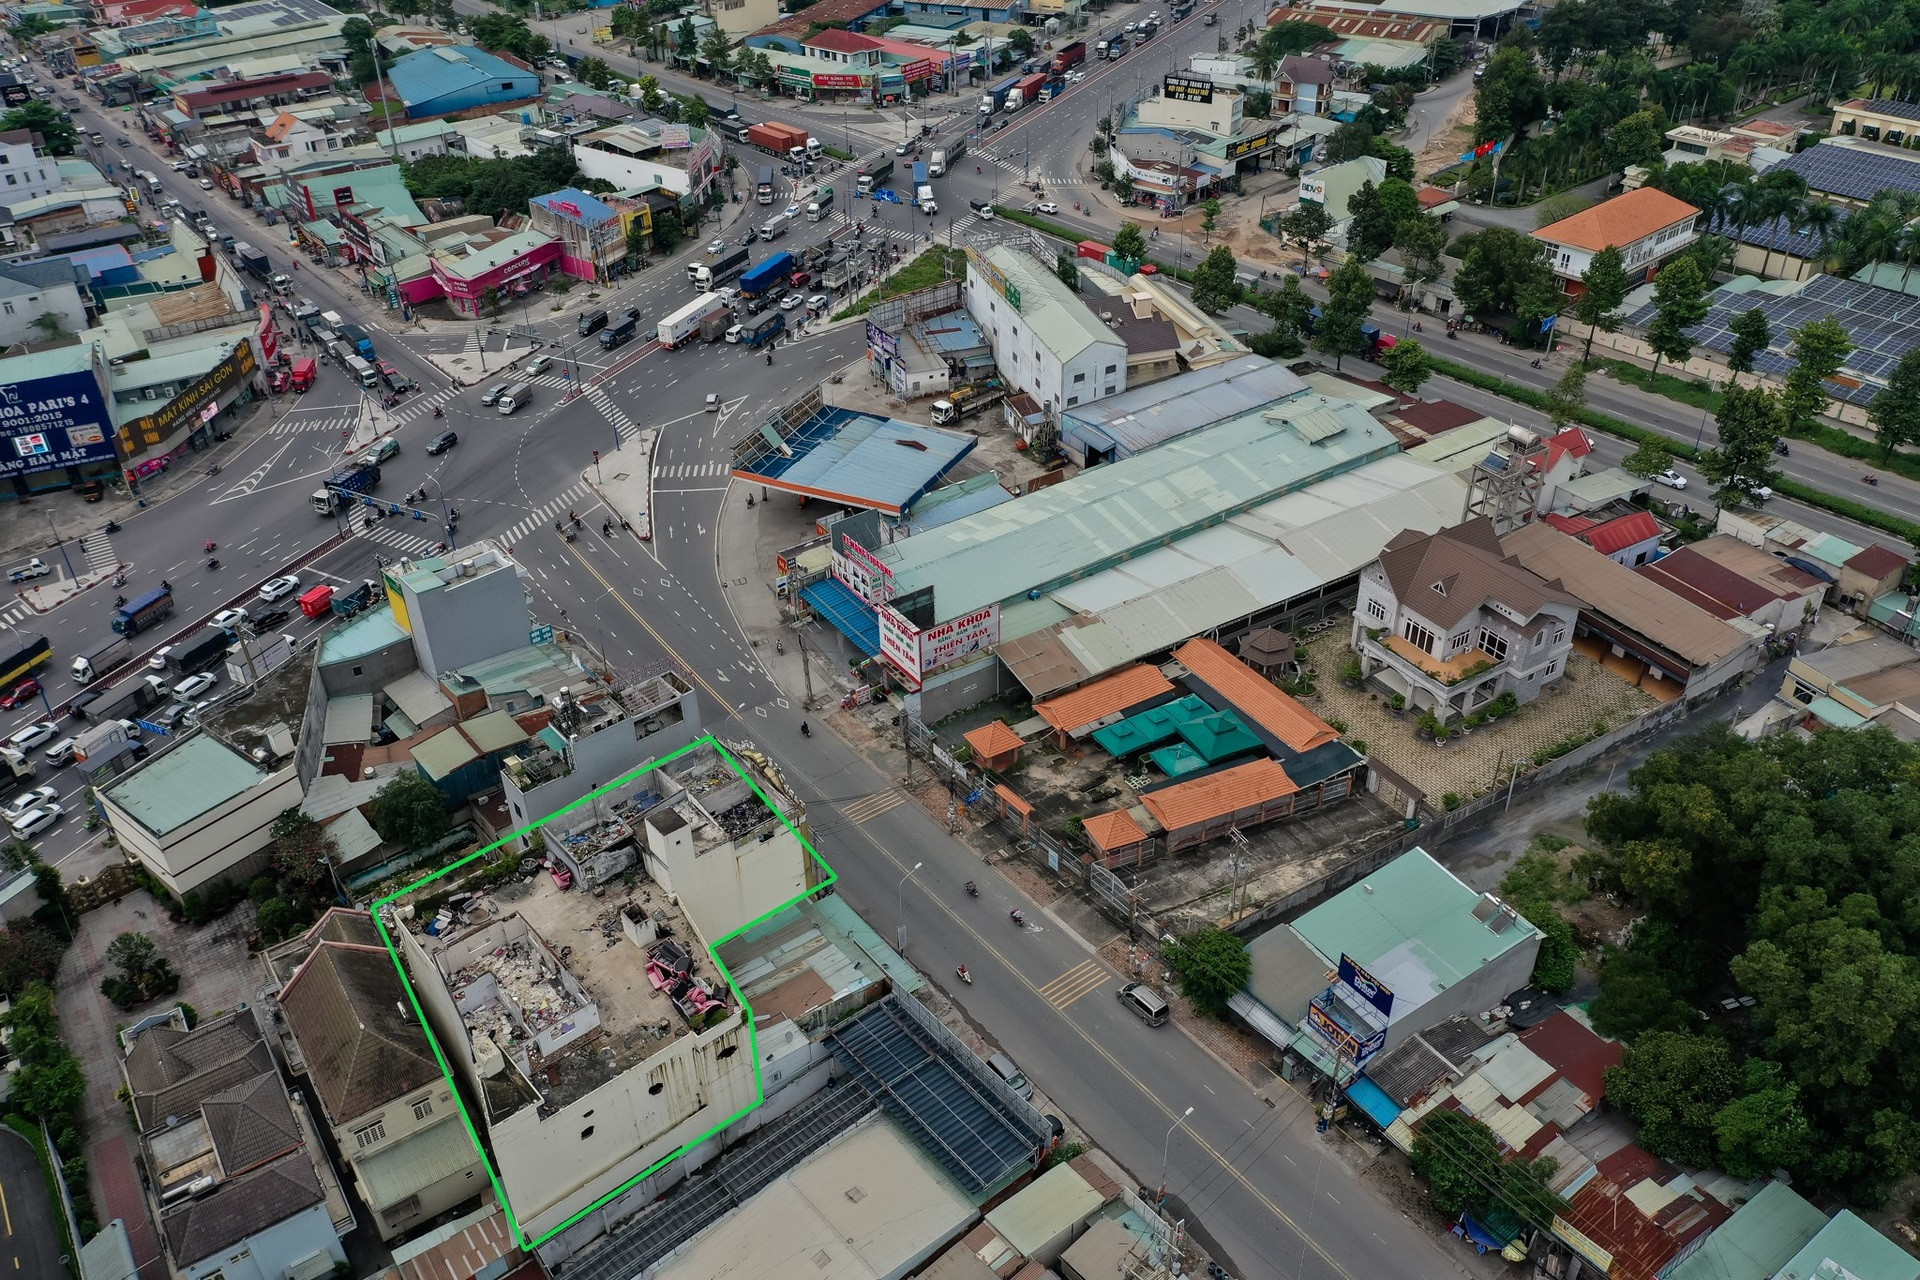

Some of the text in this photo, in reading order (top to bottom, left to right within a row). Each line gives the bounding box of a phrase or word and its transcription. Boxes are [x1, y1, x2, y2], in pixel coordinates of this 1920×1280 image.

[178, 390, 199, 414] KÍNH
[199, 378, 214, 399] SÀI
[214, 362, 234, 384] GÒN
[27, 396, 76, 413] PARI'S
[80, 393, 89, 404] 4
[2, 411, 63, 428] 9001:2015
[28, 454, 57, 466] HÀM
[60, 447, 87, 460] MẶT
[927, 610, 991, 641] NHA KHOA
